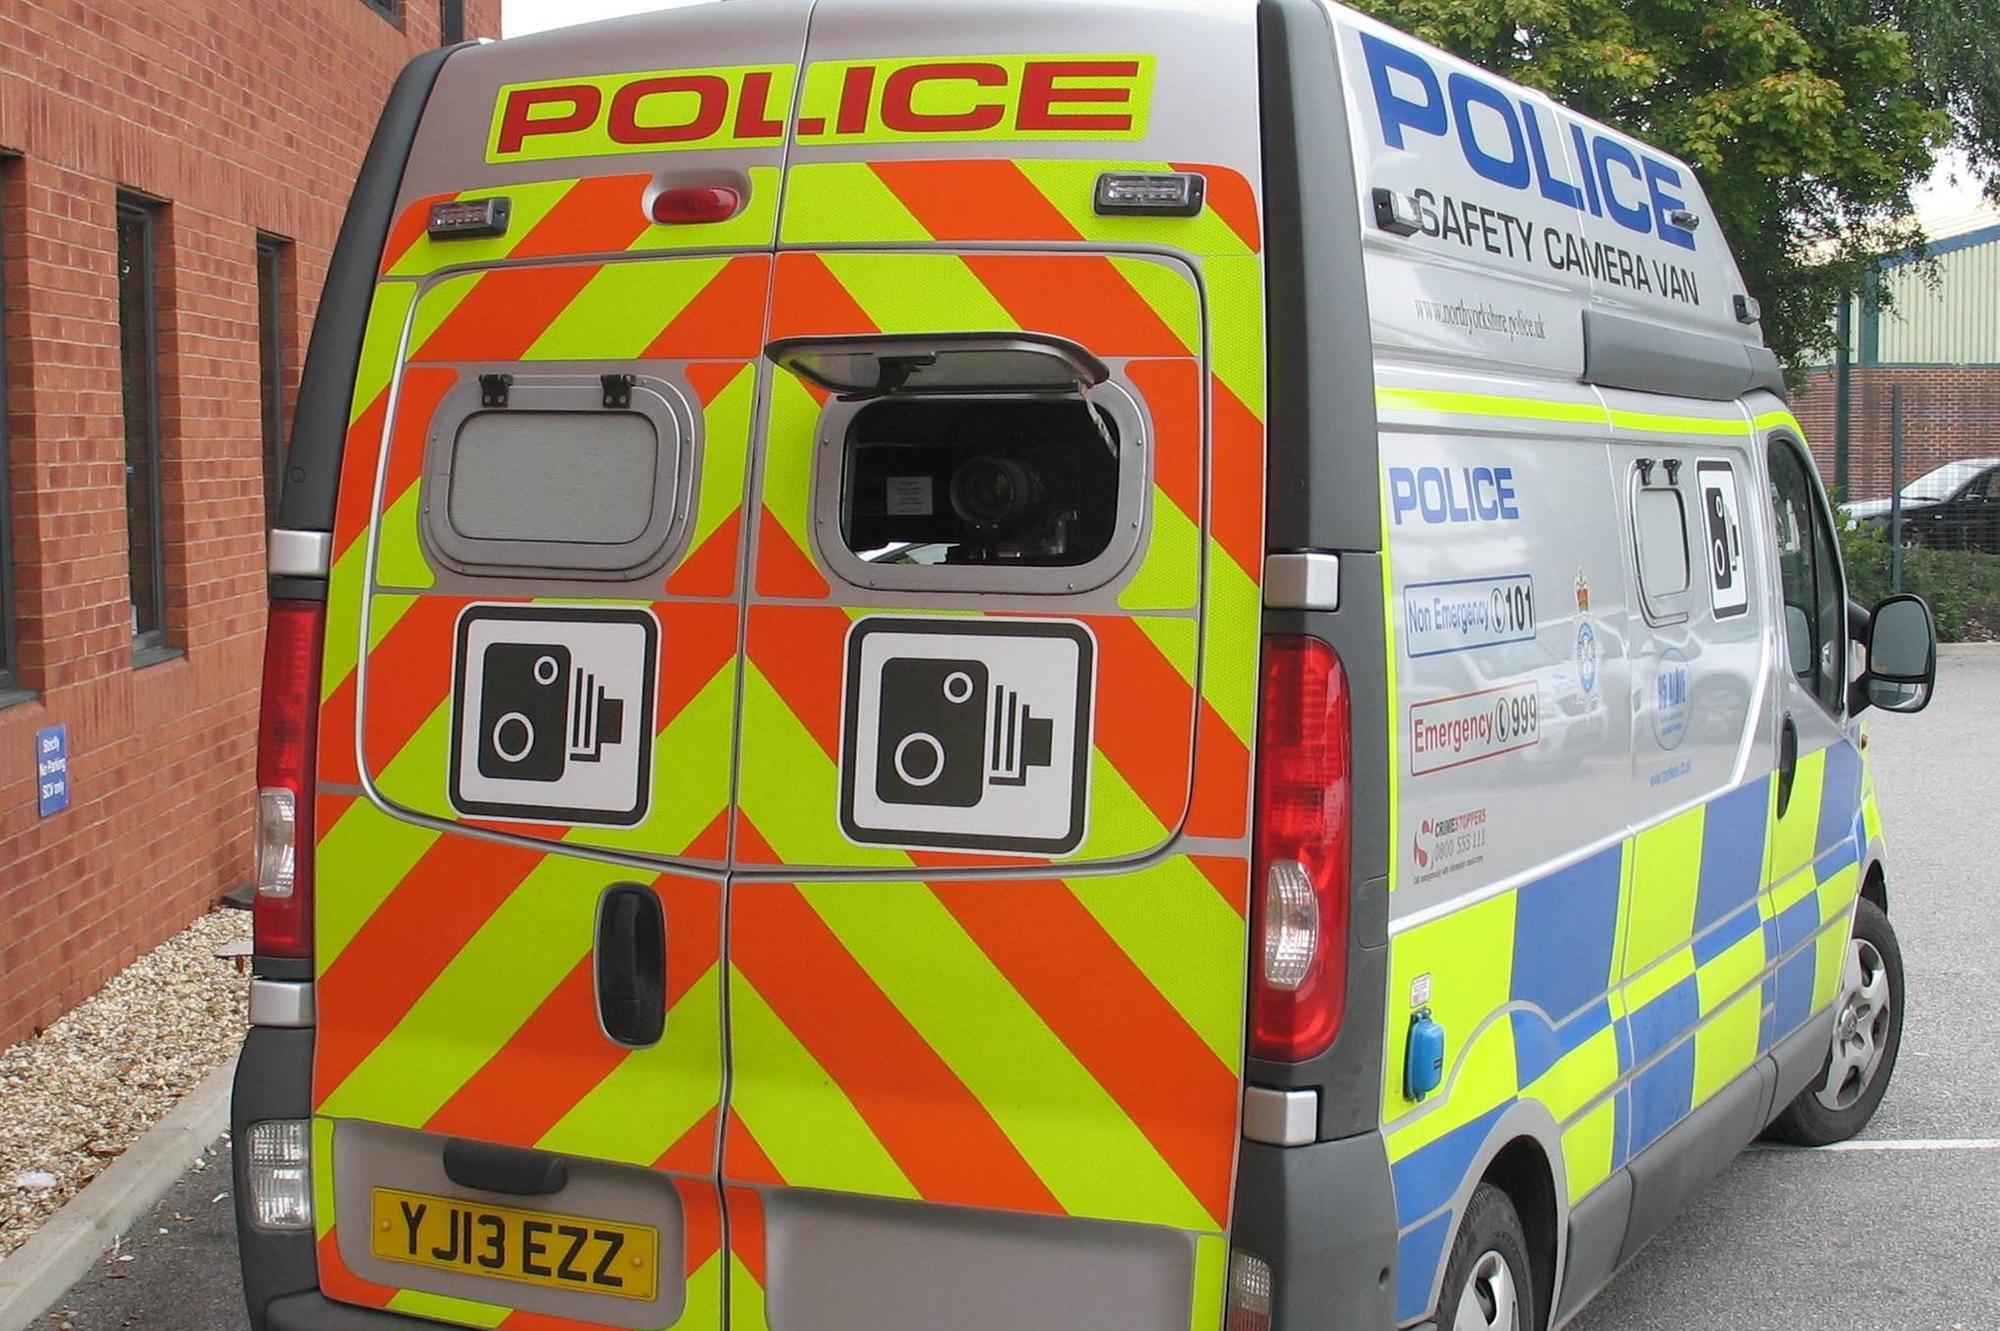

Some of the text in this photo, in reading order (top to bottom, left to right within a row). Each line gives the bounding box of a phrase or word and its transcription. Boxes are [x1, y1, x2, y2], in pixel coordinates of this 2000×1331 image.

[496, 61, 1140, 155] POLICE
[1359, 31, 1697, 252] POLICE
[1414, 187, 1700, 306] SAFETY CAMERA VAN
[1389, 466, 1519, 525] POLICE
[1408, 585, 1533, 635] Non Emergency 101
[1414, 694, 1537, 753] Emergency 999
[1434, 828, 1485, 863] 0800 555 111
[1435, 807, 1486, 838] CRIMESTOPPERS
[400, 1200, 625, 1288] YJ13 EZZ
